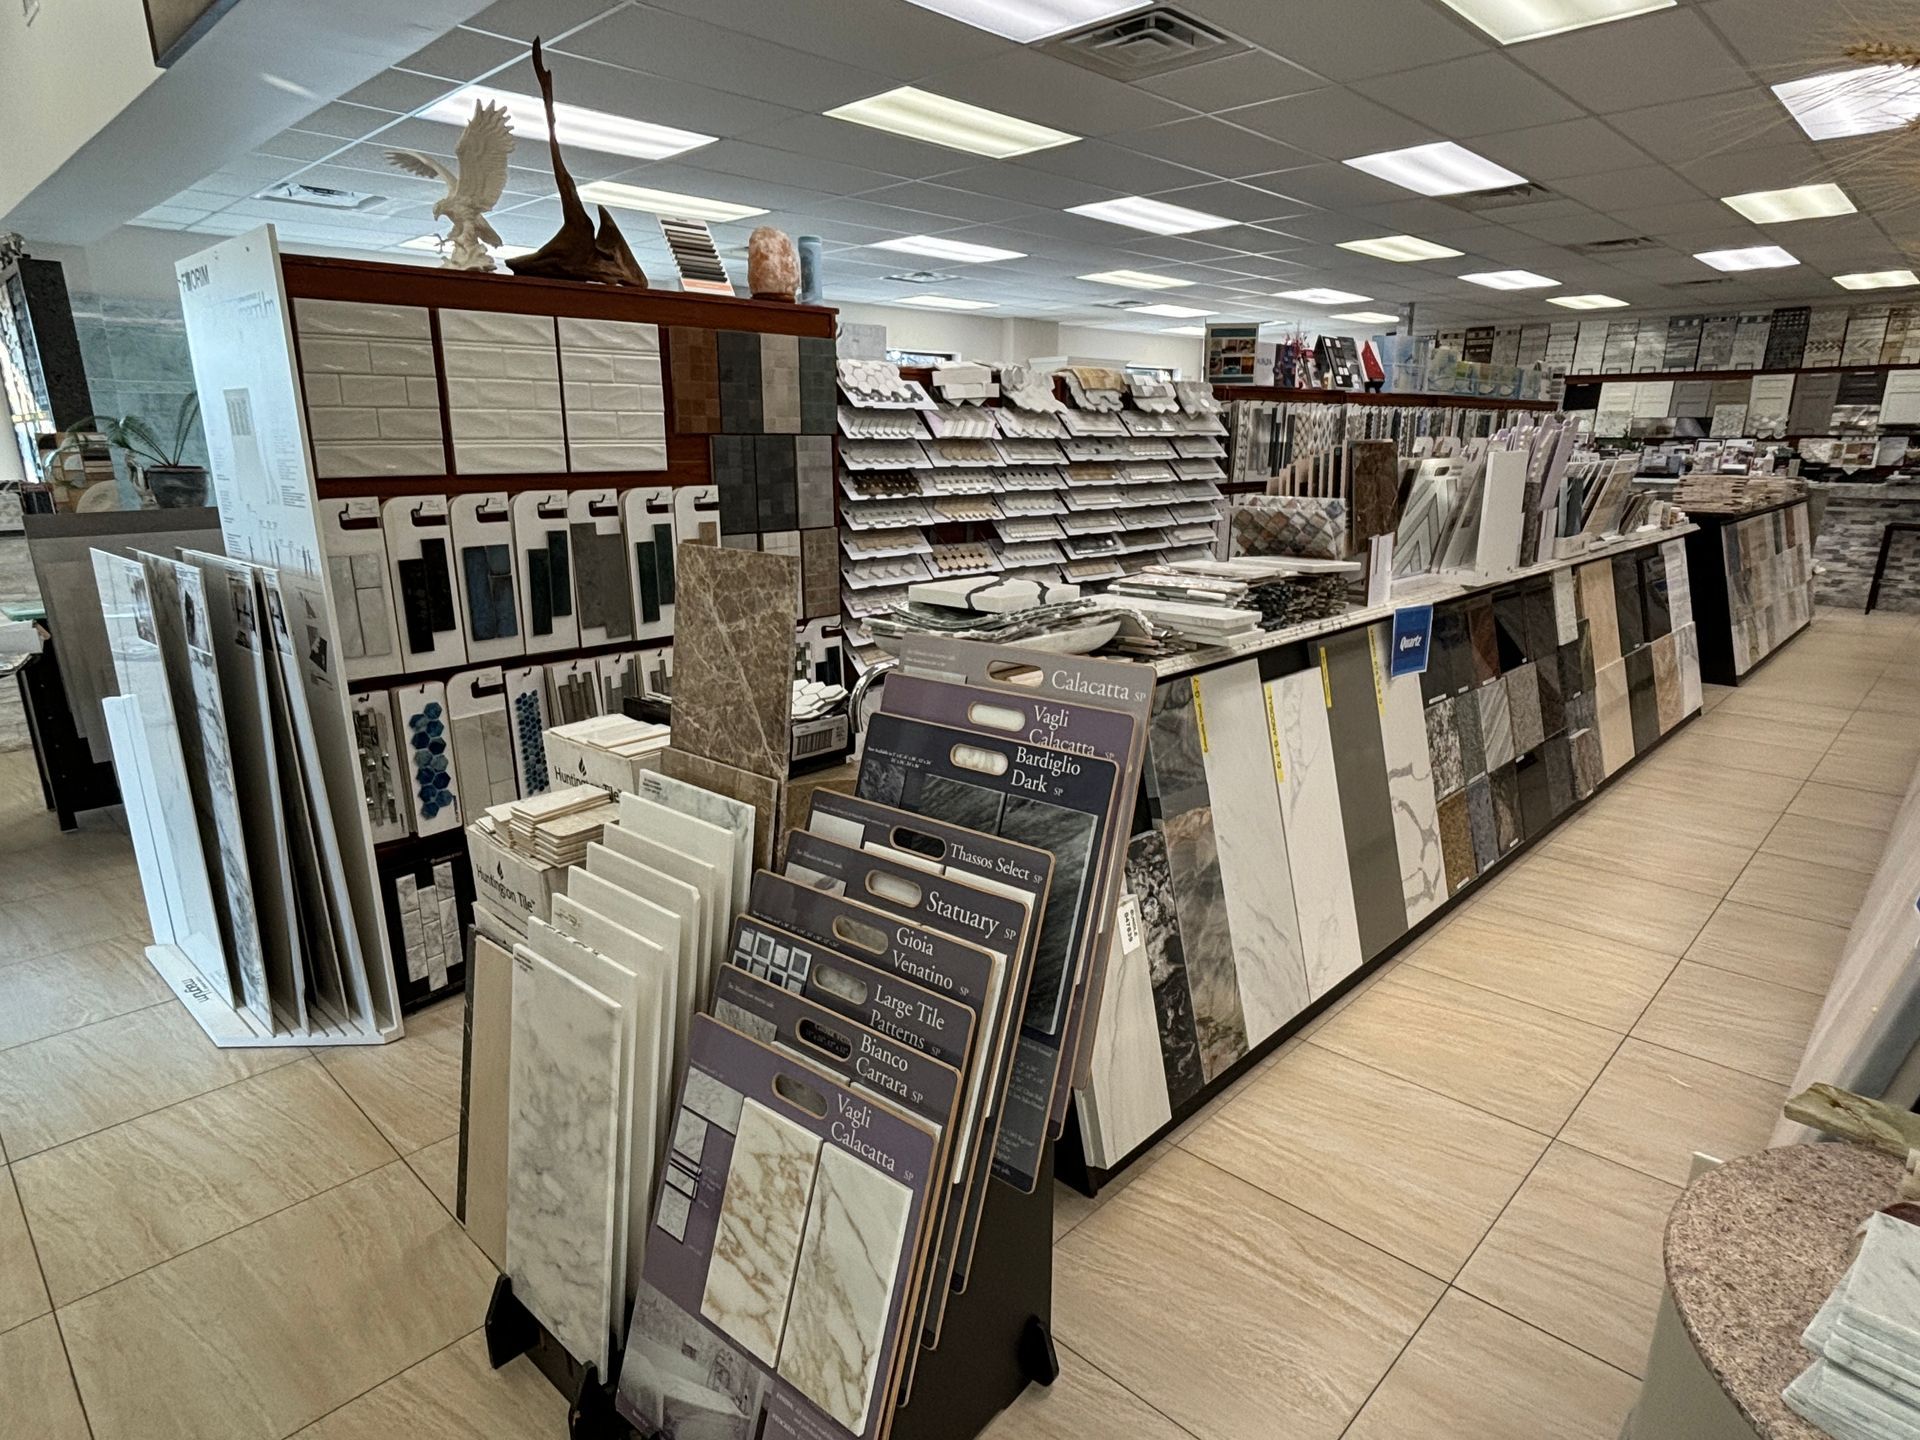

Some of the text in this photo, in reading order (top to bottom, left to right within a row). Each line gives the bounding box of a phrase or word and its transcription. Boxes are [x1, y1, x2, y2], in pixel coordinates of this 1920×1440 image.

[1400, 634, 1422, 652] Quartz
[1051, 670, 1147, 702] Calacatta SP
[1033, 705, 1070, 730] Vagli
[1029, 728, 1096, 757] Calacatta
[1016, 746, 1081, 777] Bardiglio
[1011, 768, 1064, 797] Dark SP
[950, 842, 1043, 884] Thassos Select SP
[517, 891, 533, 913] Tile
[926, 890, 1017, 939] Statuary SP
[896, 926, 934, 957] Gioia
[891, 951, 969, 997] Venatino SP
[873, 984, 945, 1031] Large Tile
[868, 1009, 925, 1050] Patterns
[931, 1046, 941, 1057] SP
[860, 1034, 909, 1072] Bianco
[855, 1057, 924, 1104] Carrara SP
[835, 1092, 873, 1129] Vagli
[830, 1122, 915, 1181] Calacatta SP
